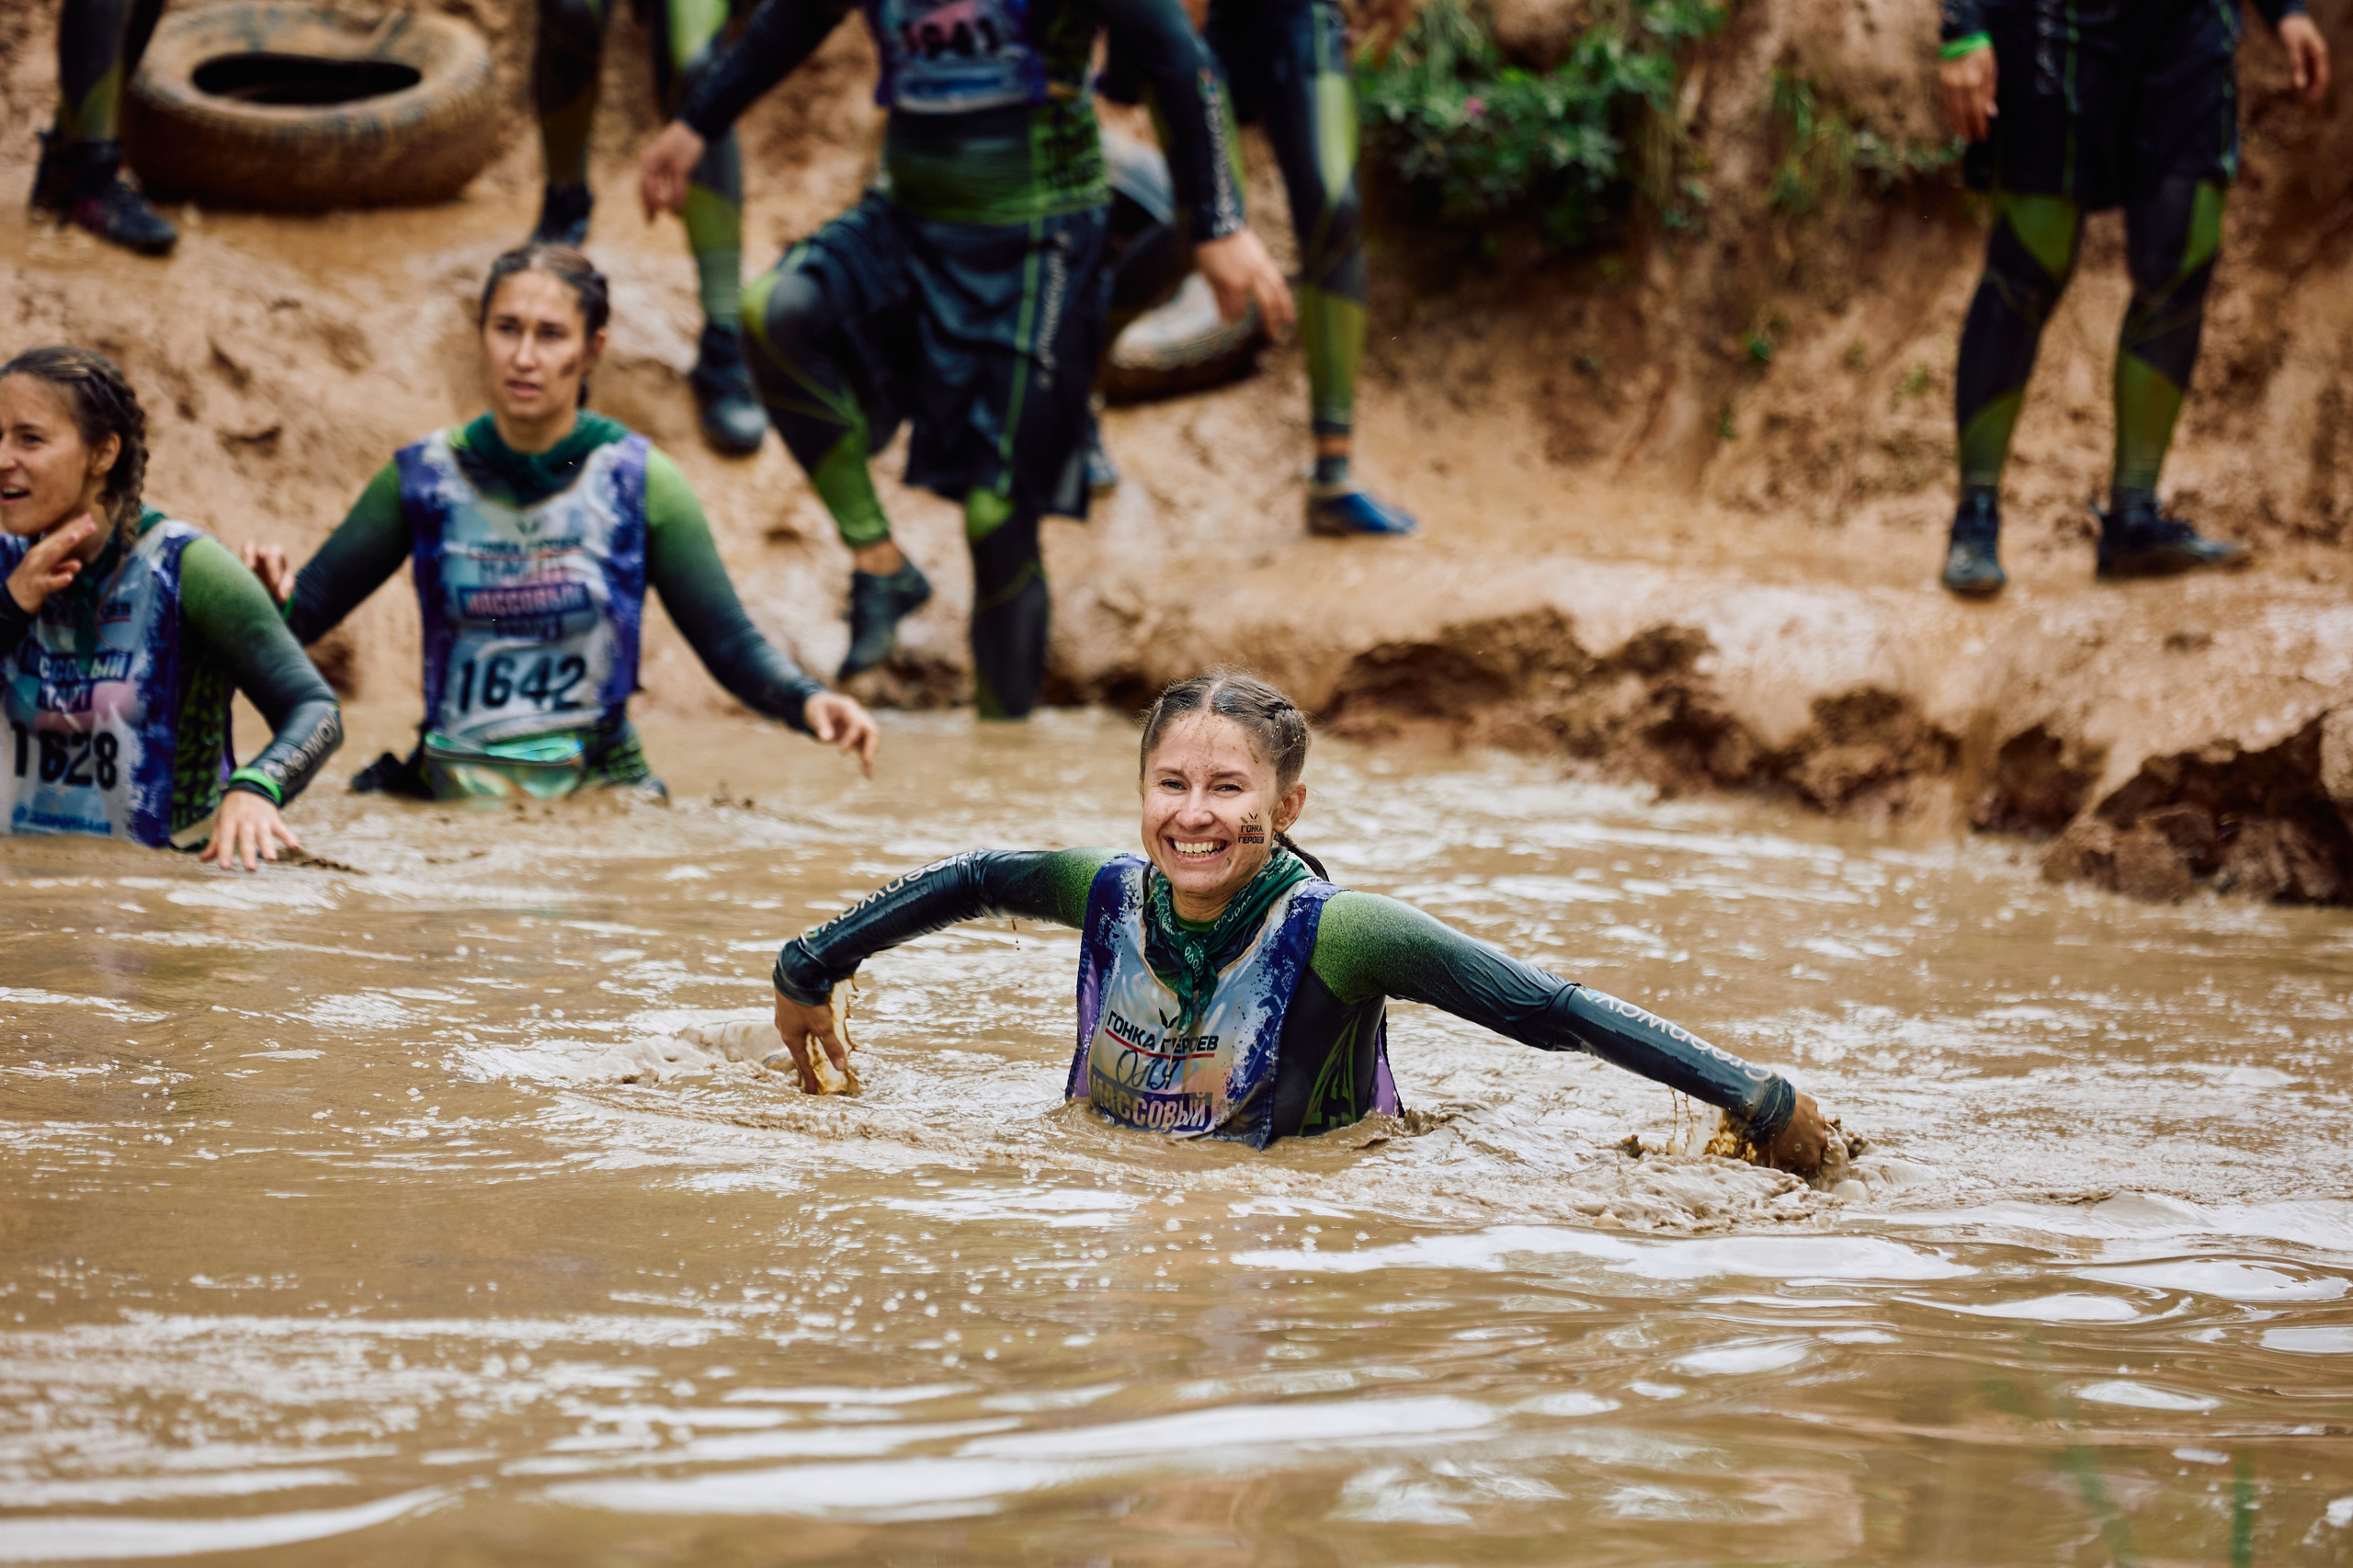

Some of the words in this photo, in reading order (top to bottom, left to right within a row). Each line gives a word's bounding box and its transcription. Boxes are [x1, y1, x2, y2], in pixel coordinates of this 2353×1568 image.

[460, 655, 587, 714] 1642
[9, 719, 119, 791] 1628
[1237, 835, 1265, 844] ГЕРОЕВ
[1241, 824, 1264, 833] ГОНКА
[1107, 1009, 1156, 1051] ГОНКА
[1160, 1035, 1220, 1054] ГЕРОЕВ
[1092, 1075, 1208, 1129] МАССОВЫЙ
